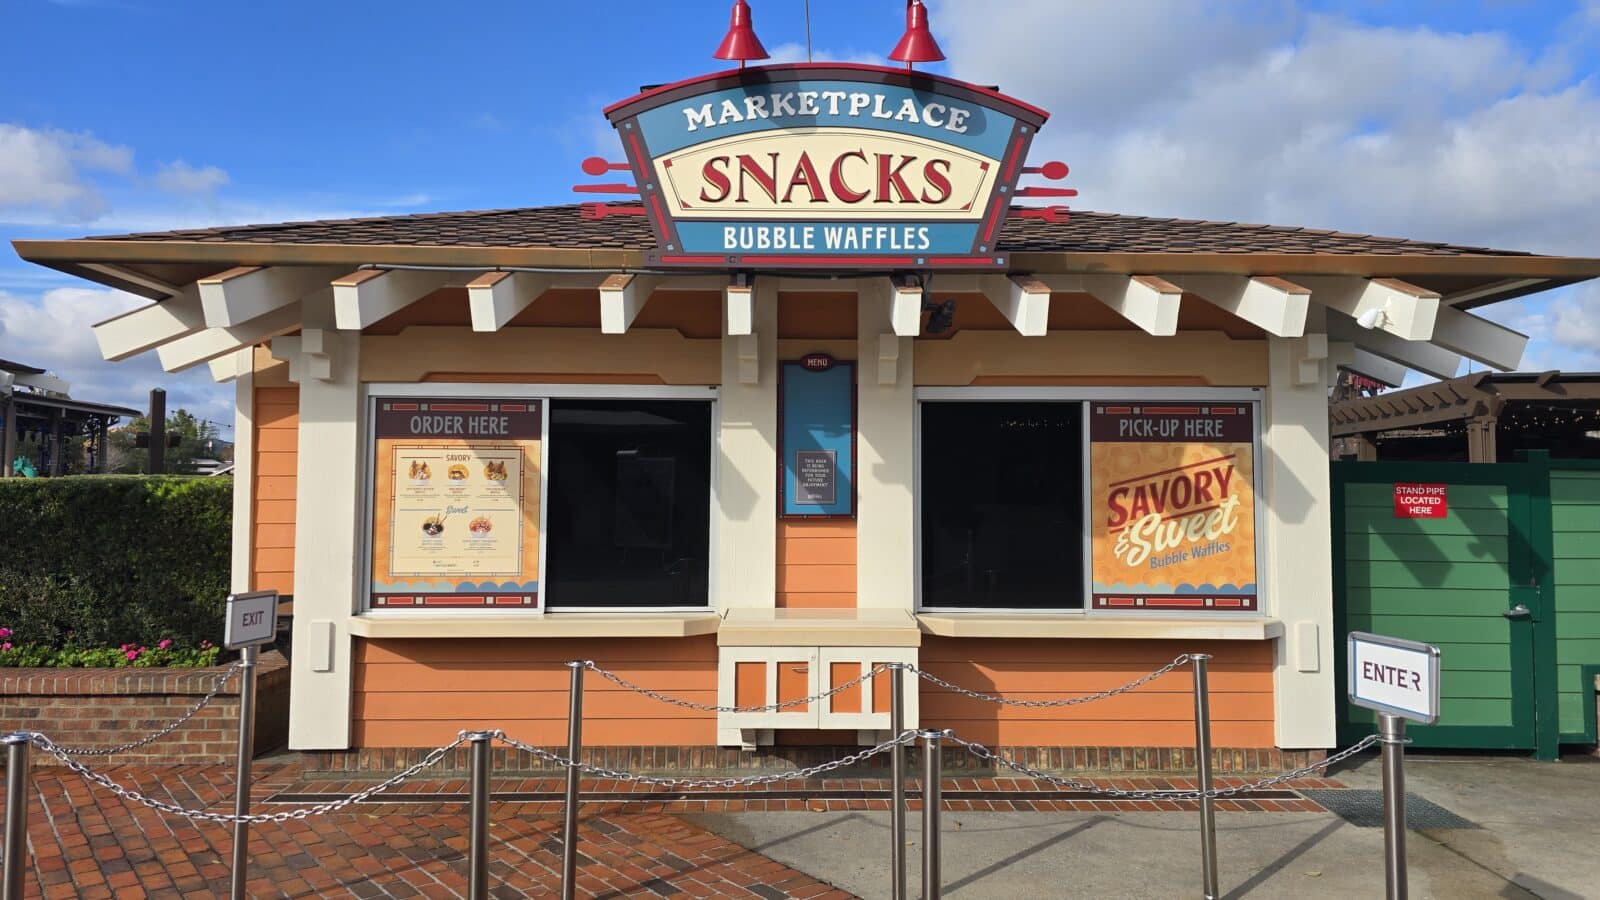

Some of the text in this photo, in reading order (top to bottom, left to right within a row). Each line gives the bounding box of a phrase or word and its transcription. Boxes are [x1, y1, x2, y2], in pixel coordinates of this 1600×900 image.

[682, 90, 970, 134] MARKETPLACE
[699, 148, 952, 204] SNACKS
[723, 227, 930, 250] BUBBLE WAFFLES
[807, 359, 828, 367] MENU
[410, 416, 509, 434] ORDER HERE
[1119, 419, 1224, 437] PICK-UP HERE
[445, 454, 471, 462] SAVORY
[1107, 464, 1235, 528] SAVORY
[1426, 487, 1445, 495] PIPE
[1400, 496, 1441, 505] LOCATED
[1409, 506, 1433, 515] HERE
[1126, 493, 1241, 567] Sweet
[1149, 540, 1231, 569] Bubble Waffles
[242, 611, 264, 626] EXIT
[1363, 660, 1422, 692] ENTER
